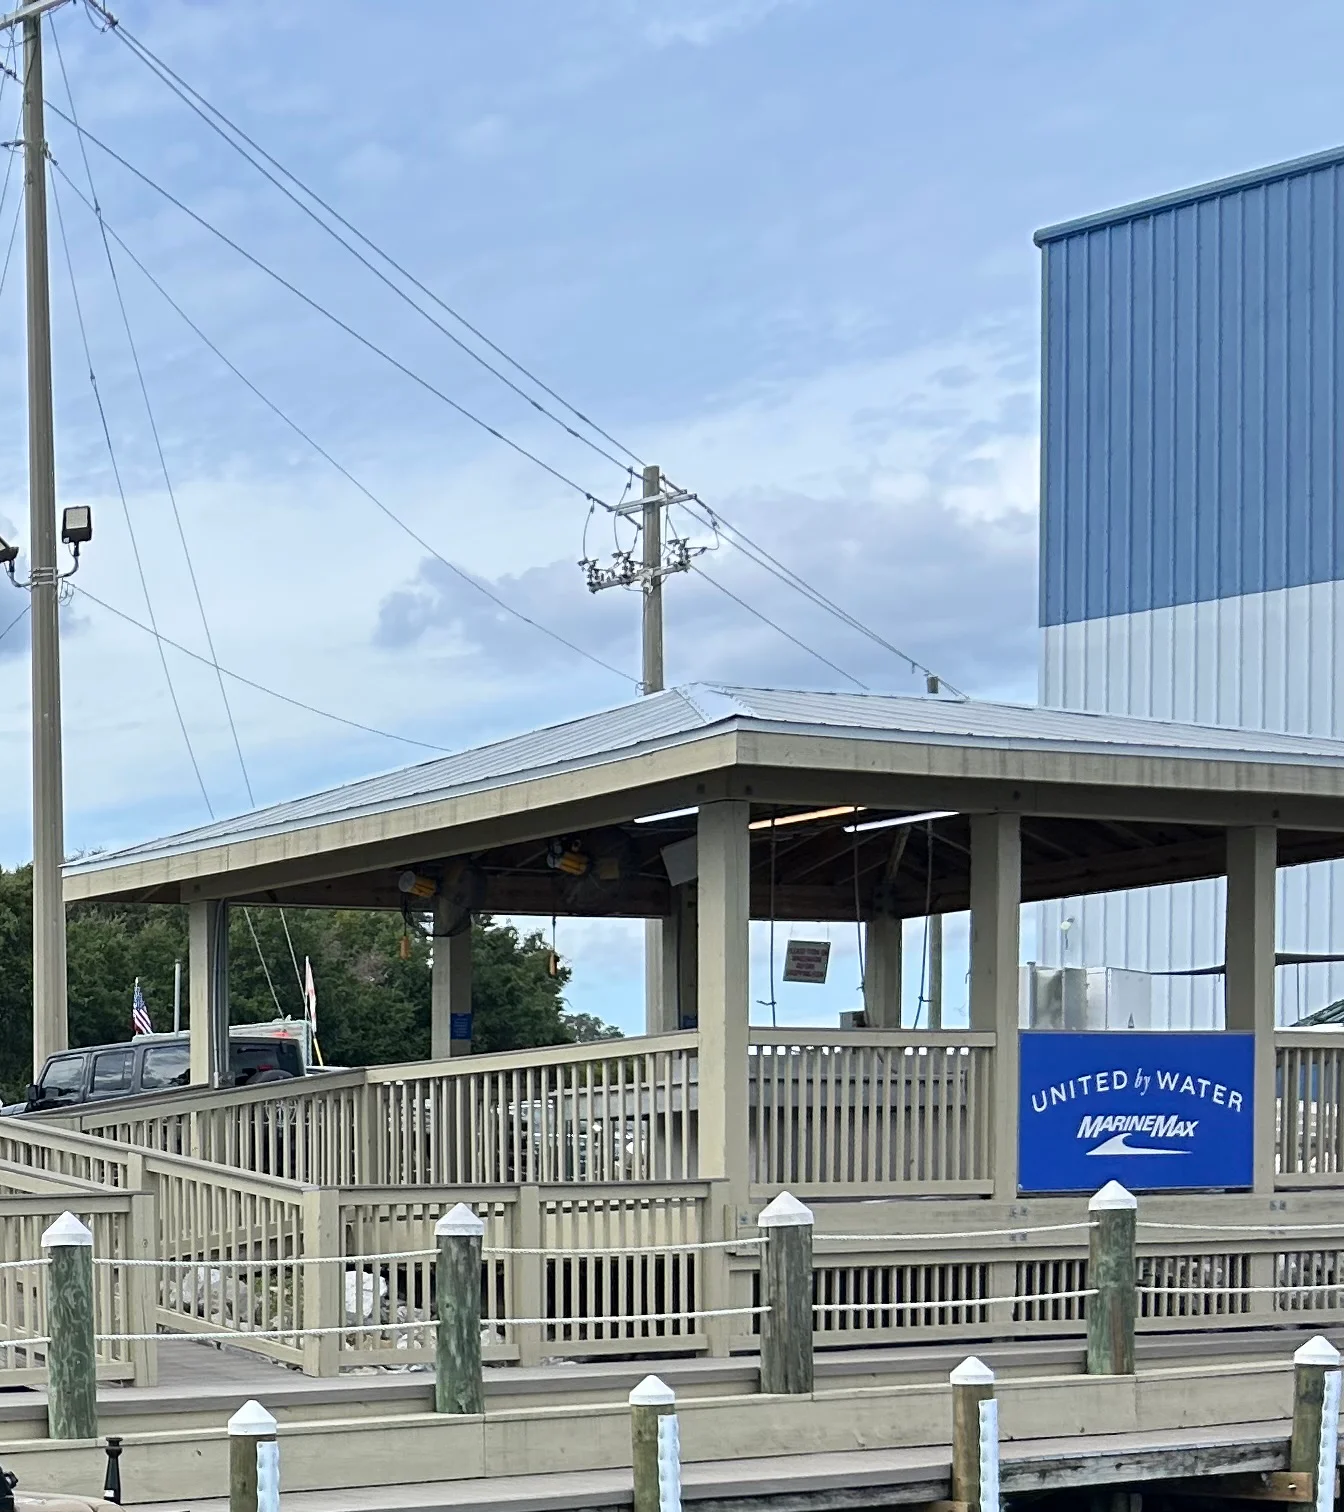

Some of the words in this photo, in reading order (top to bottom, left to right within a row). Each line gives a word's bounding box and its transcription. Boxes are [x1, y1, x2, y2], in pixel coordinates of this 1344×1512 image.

[1032, 1070, 1128, 1113] UNITED
[1134, 1068, 1151, 1096] by
[1156, 1070, 1243, 1113] WATER
